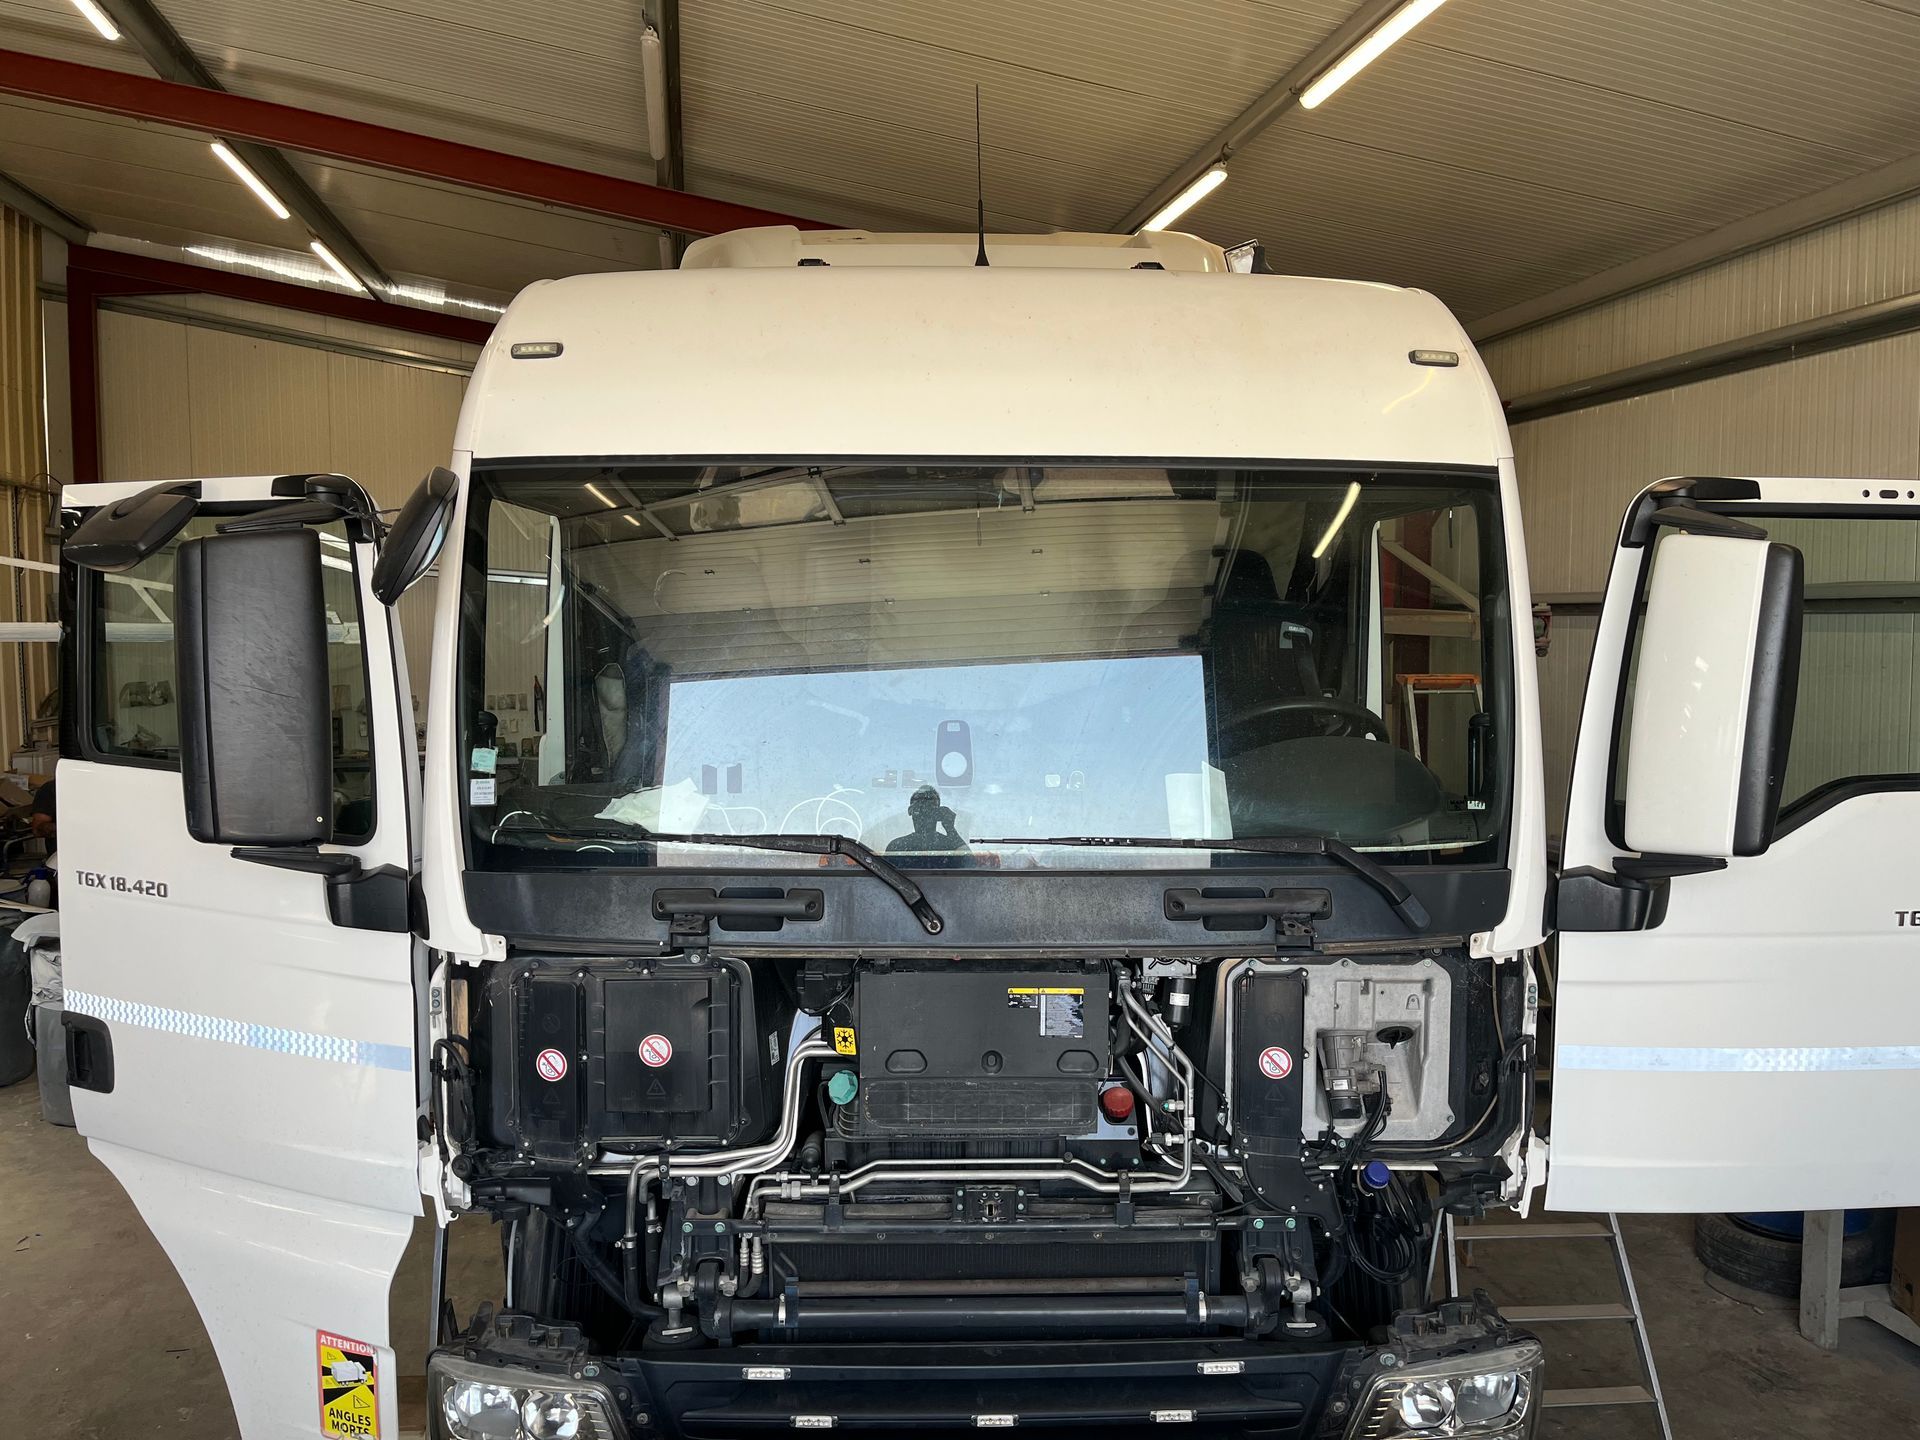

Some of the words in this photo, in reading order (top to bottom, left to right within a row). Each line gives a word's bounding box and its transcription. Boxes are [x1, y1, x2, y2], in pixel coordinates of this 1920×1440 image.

[76, 870, 107, 889] TGX
[110, 876, 169, 898] 18.420
[320, 1335, 374, 1354] ATTENTION
[329, 1407, 372, 1426] ANGLES
